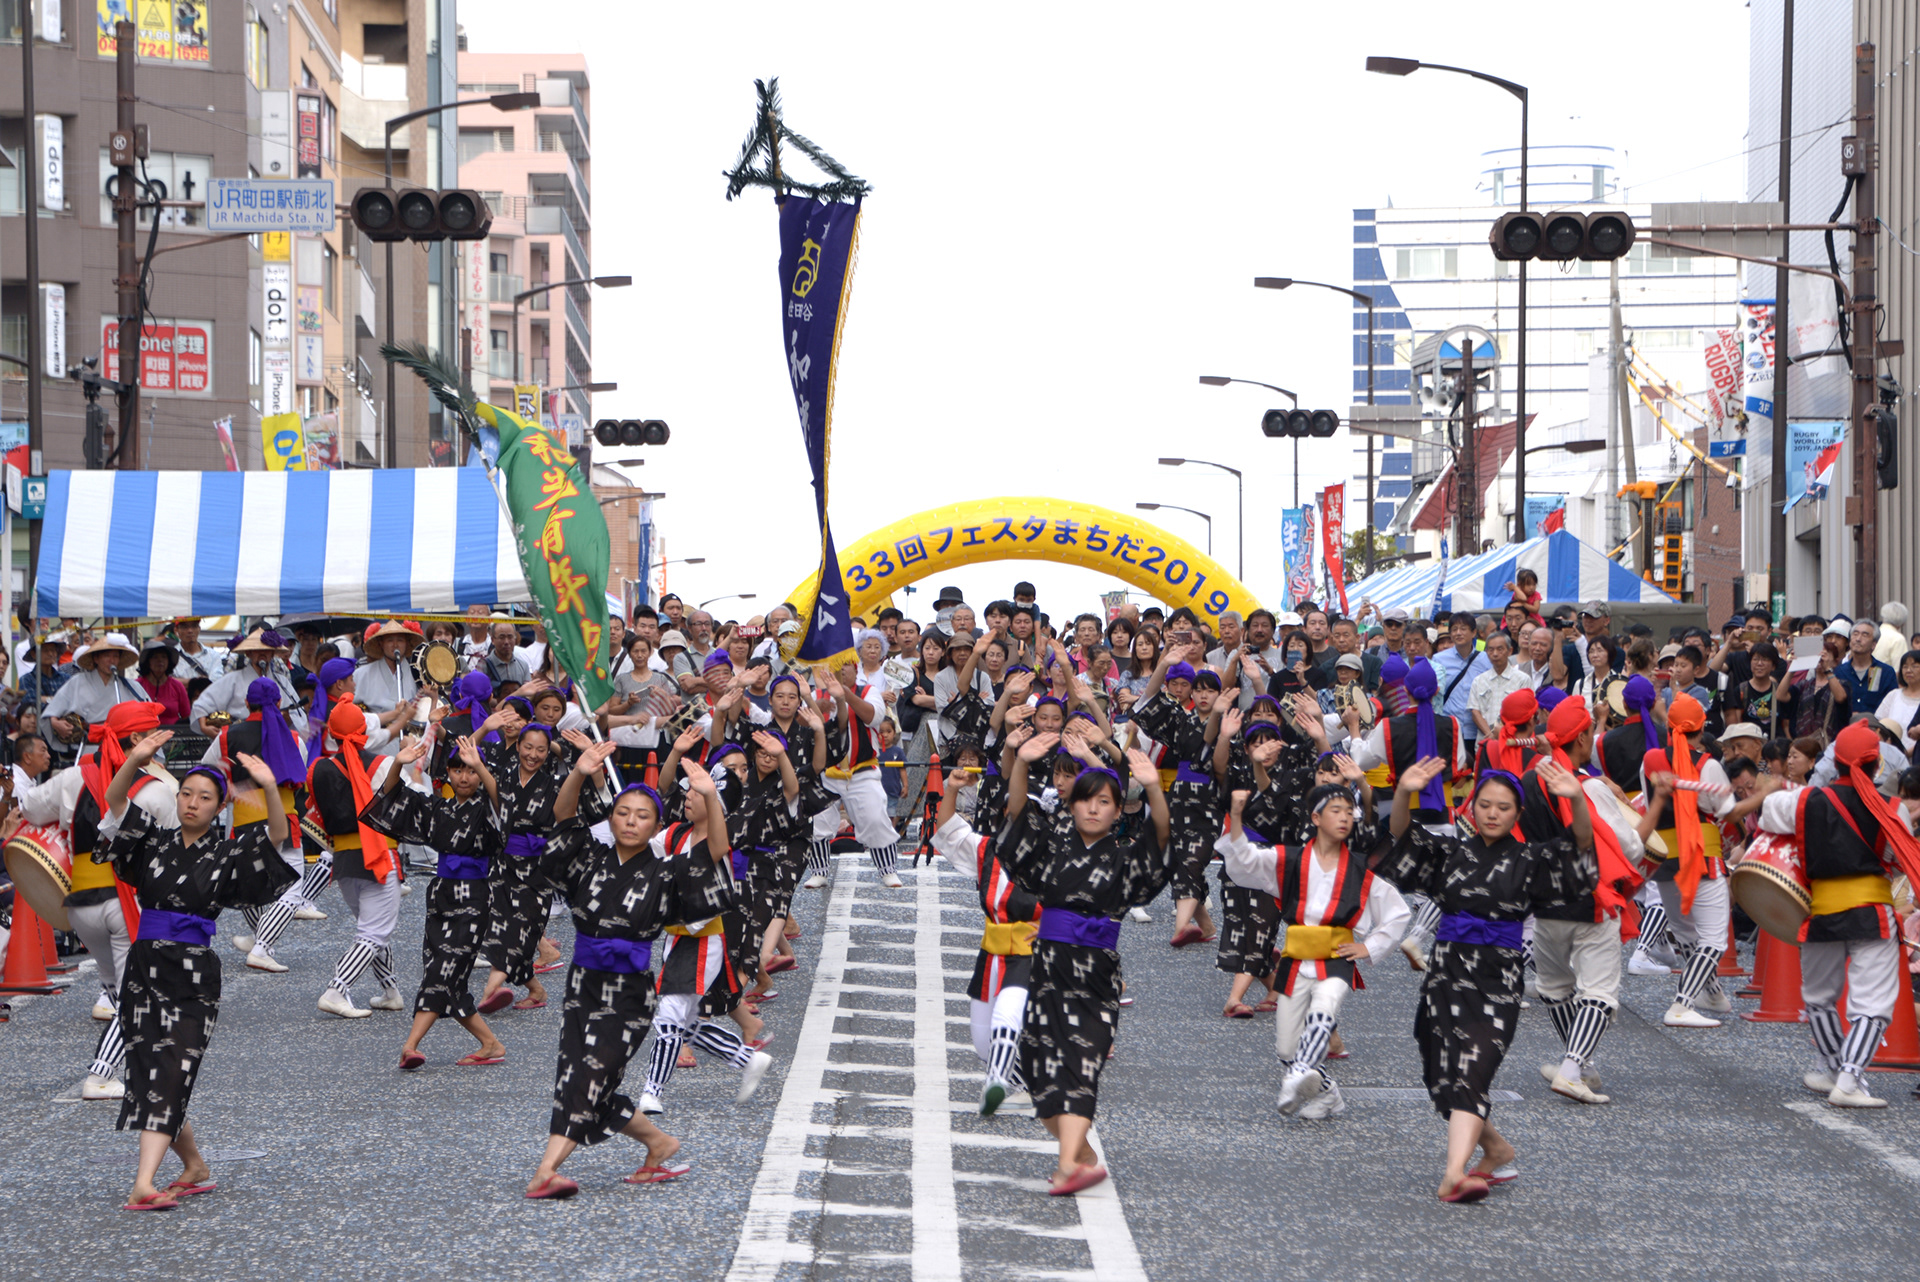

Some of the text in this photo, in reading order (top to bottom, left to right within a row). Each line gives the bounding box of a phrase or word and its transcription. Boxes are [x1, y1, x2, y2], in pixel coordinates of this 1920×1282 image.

[213, 188, 327, 209] JR町田駅前北
[215, 211, 328, 223] JR Machida Sta. N.
[268, 289, 286, 330] dot.
[265, 335, 289, 343] tokyo
[1704, 344, 1737, 397] RUGBY
[272, 373, 284, 410] iPhone
[1758, 401, 1771, 414] 3F
[1722, 443, 1736, 455] 3F
[738, 626, 761, 636] CHUMS
